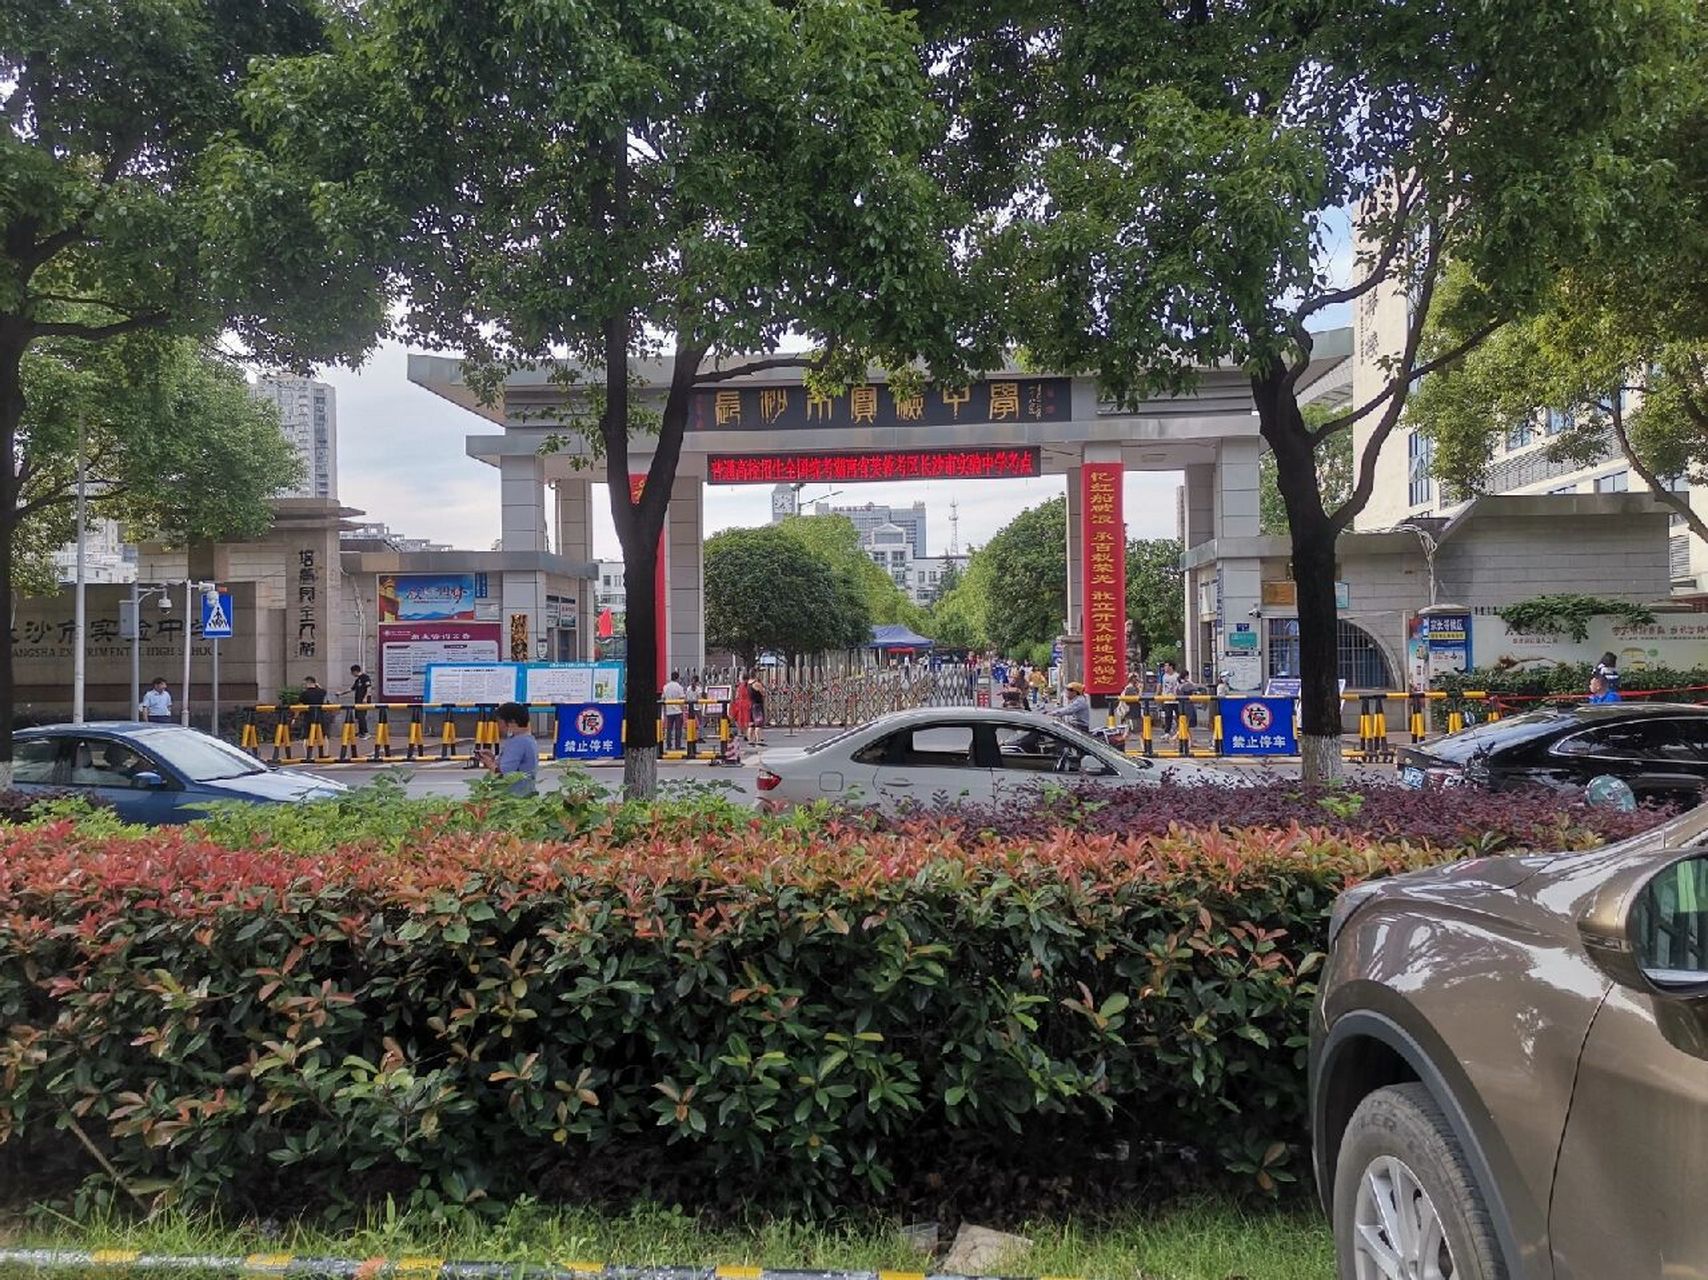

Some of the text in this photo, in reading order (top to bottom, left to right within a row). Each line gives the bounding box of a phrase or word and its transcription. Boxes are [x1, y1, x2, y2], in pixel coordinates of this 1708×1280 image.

[564, 739, 614, 753] 禁止停车
[1232, 735, 1287, 749] 禁止停车
